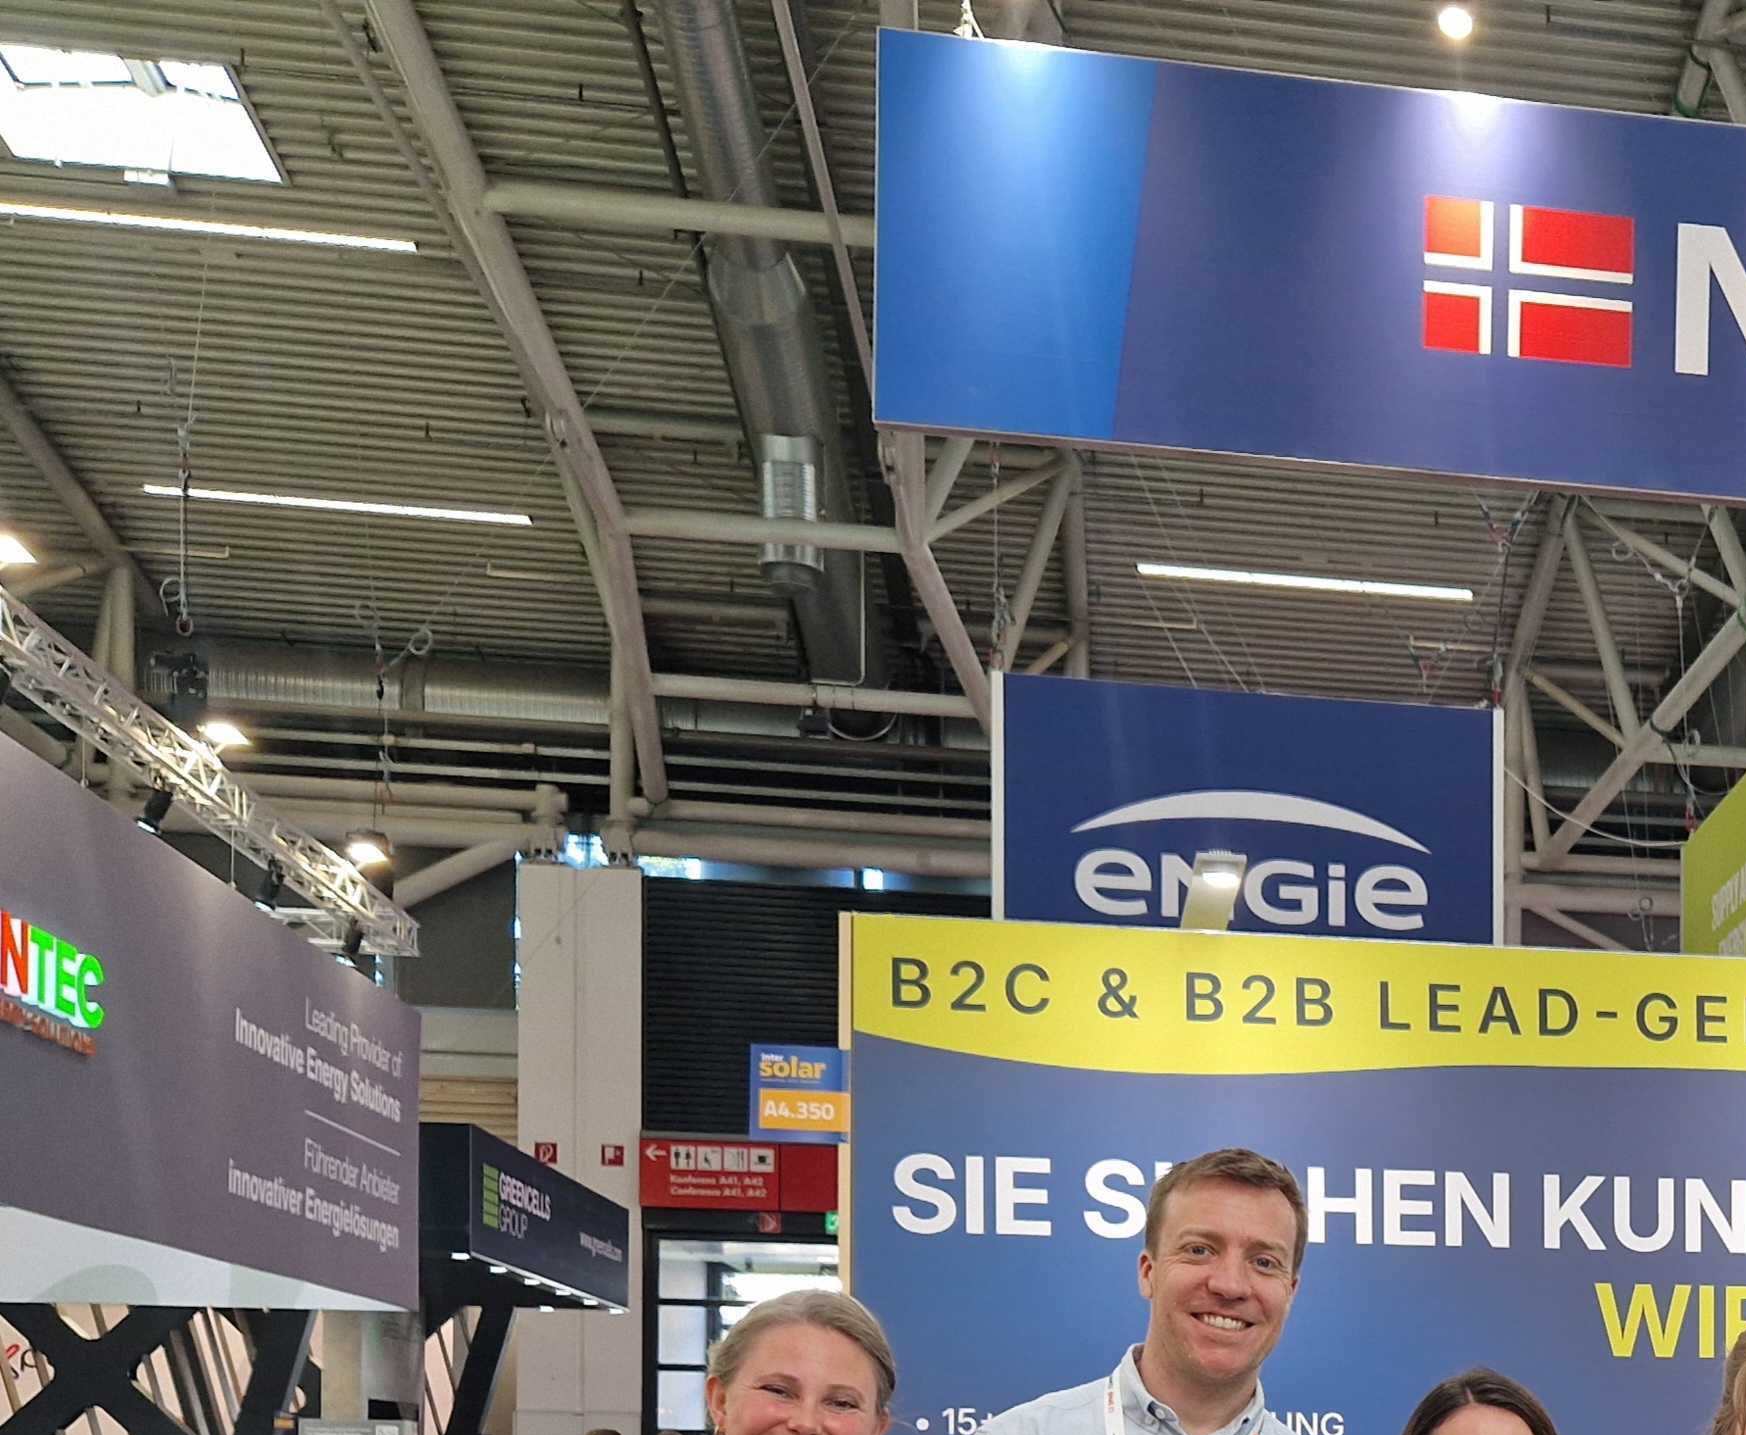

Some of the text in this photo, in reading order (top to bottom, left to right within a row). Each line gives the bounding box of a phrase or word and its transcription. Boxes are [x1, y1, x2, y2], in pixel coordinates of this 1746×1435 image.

[891, 956, 1051, 1016] B2C
[1098, 967, 1138, 1020] &
[1184, 971, 1334, 1027] B2B
[235, 1007, 401, 1122] Innovative Energy Solutions
[305, 997, 402, 1077] Leading Provider of
[759, 1056, 827, 1079] solar
[764, 1099, 836, 1121] A4.350
[228, 1158, 399, 1252] innovativer Energielösungen
[304, 1137, 400, 1205] Führender Anbieter
[499, 1172, 551, 1222] GREENCELLS
[892, 1153, 1052, 1238] SIE
[1083, 1158, 1511, 1250] SHEN
[500, 1204, 529, 1240] GROUP
